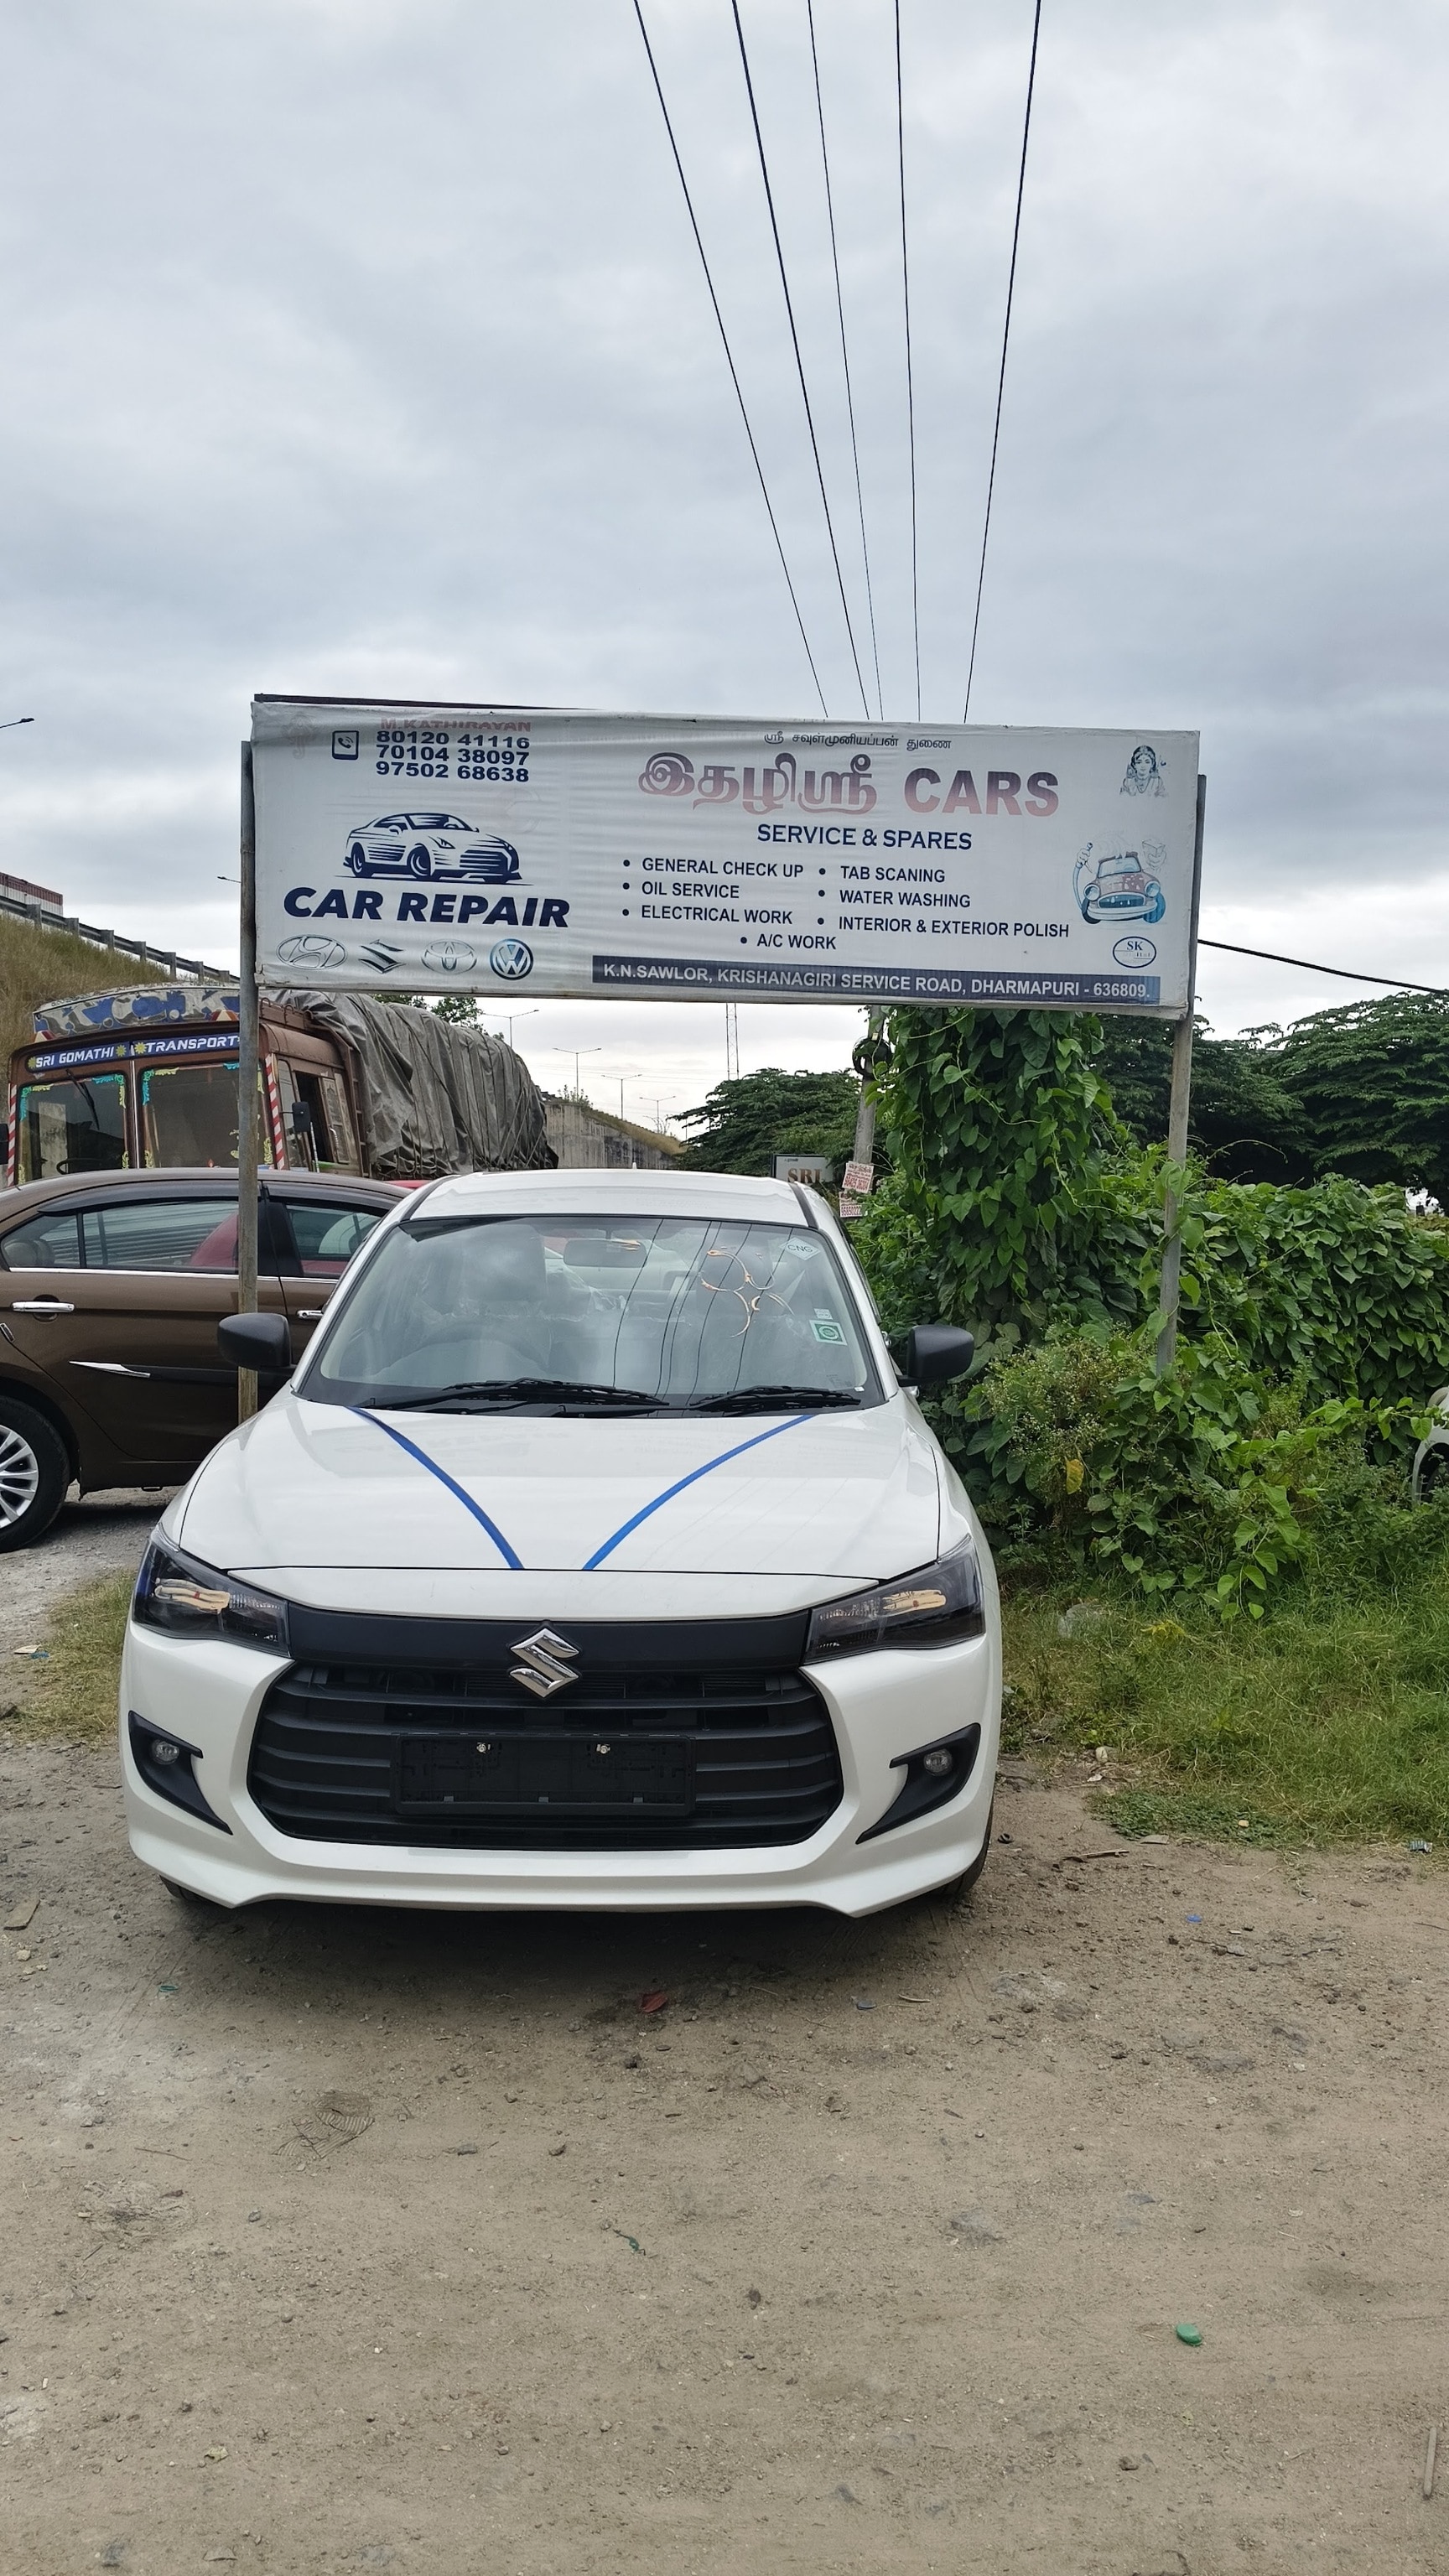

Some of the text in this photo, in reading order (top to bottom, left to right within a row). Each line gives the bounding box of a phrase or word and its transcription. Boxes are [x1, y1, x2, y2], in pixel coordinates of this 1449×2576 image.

[381, 719, 531, 732] M.KATHIRAVAN
[377, 730, 530, 749] 80120 41116
[906, 737, 952, 751] துணை
[377, 745, 530, 766] 70104 38097
[376, 761, 529, 782] 97502 68638
[904, 767, 1059, 817] CARS
[757, 823, 972, 850] SERVICE & SPARES
[641, 857, 804, 878] GENERAL CHECK UP
[840, 866, 945, 883] TAB SCANING
[641, 881, 740, 899] OIL SERVICE
[839, 890, 971, 908] WATER WASHING
[283, 886, 570, 928] CAR REPAIR
[641, 906, 793, 924] ELECTRICAL WORK
[839, 917, 1069, 937] INTERIOR & EXTERIOR POLISH
[757, 934, 837, 950] A/C WORK
[1127, 941, 1144, 951] SK
[604, 963, 713, 984] K.N.SAWLOR,
[717, 969, 836, 988] KRISHANAGIRI
[841, 974, 911, 990] SERVICE
[915, 977, 966, 995] ROAD,
[971, 979, 1079, 996] DHARMAPURI
[1093, 982, 1150, 999] 636809.
[35, 1035, 237, 1068] SRI GOMATHI TRANSPORT
[788, 1244, 813, 1253] CNG
